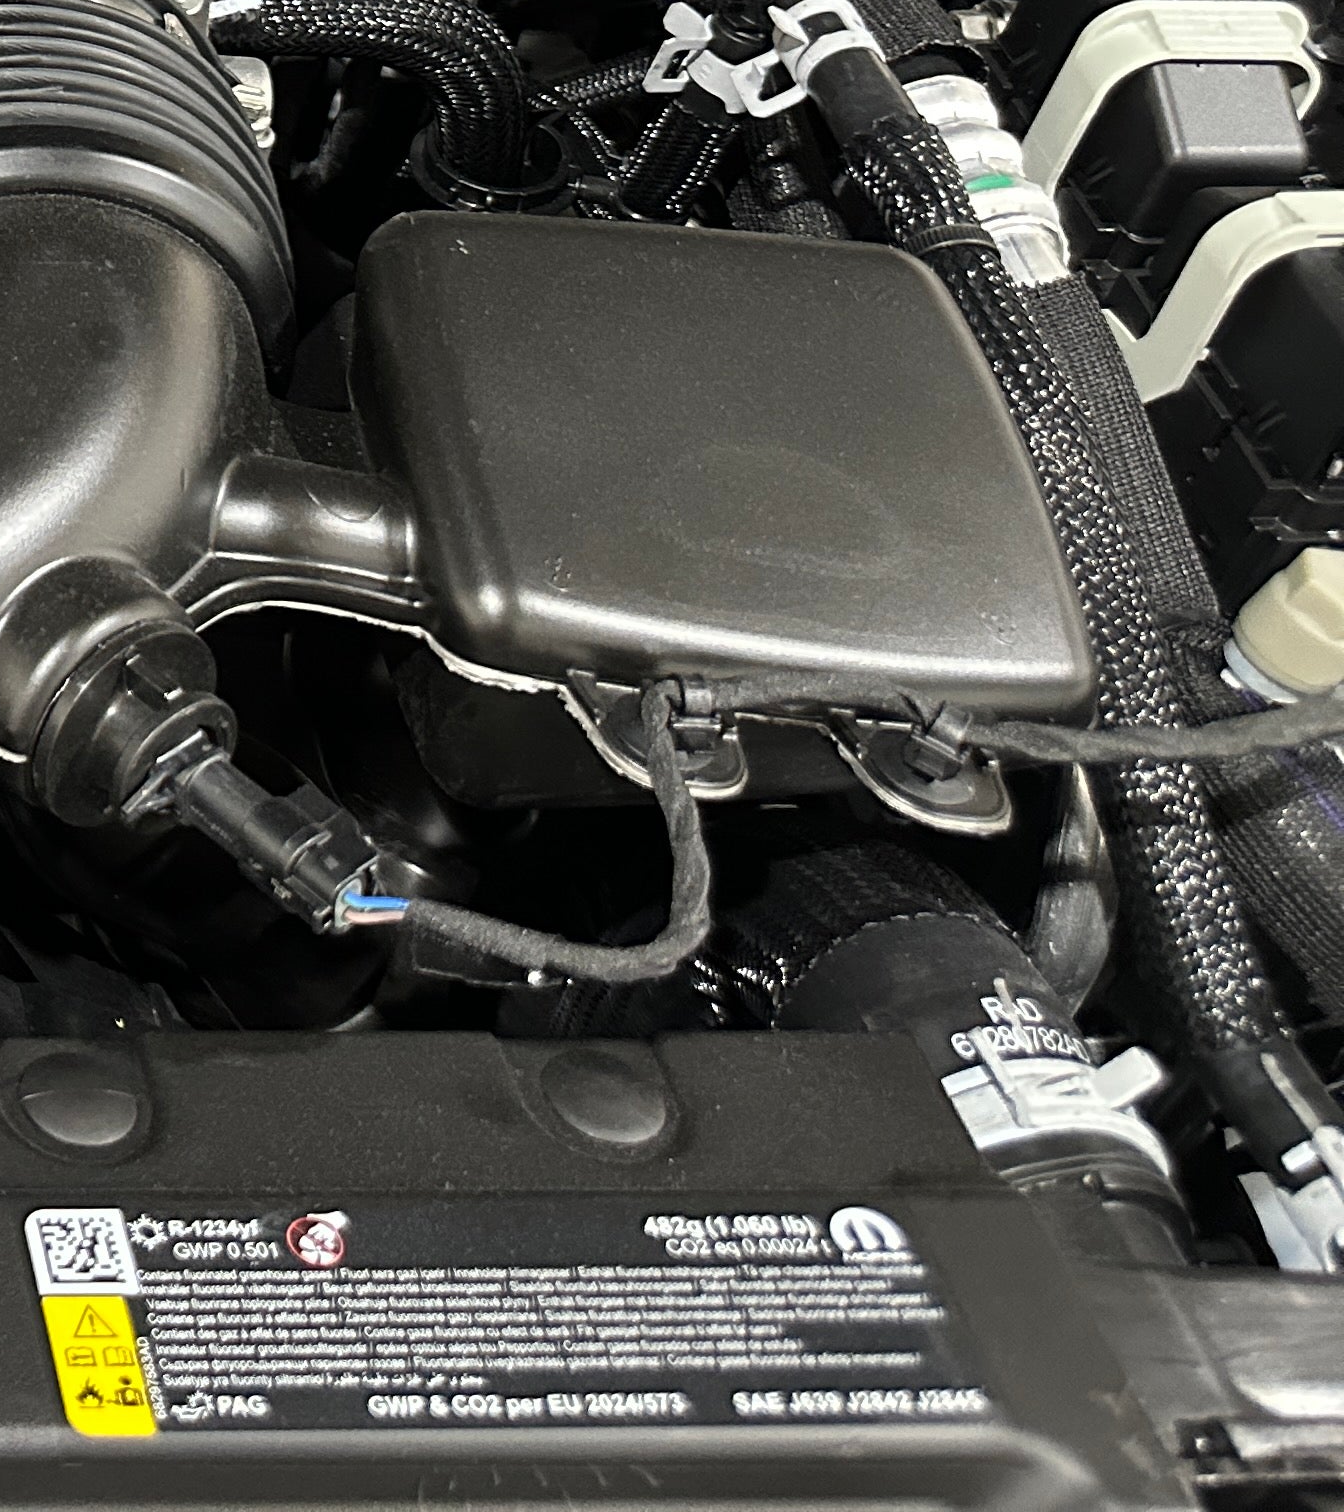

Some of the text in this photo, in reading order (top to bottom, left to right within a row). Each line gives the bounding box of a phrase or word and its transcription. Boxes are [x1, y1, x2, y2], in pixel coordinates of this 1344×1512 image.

[168, 1218, 262, 1240] R-1234yf
[173, 1241, 280, 1262] GWP 0.501
[665, 1238, 711, 1258] CO2
[714, 1241, 742, 1261] eq
[136, 1269, 182, 1281] Contains
[183, 1269, 237, 1281] fluorinated
[239, 1269, 299, 1283] greenhouse
[151, 1327, 197, 1339] Contient
[197, 1327, 217, 1339] des
[218, 1330, 238, 1342] gaz
[217, 1395, 267, 1419] PAG
[367, 1395, 426, 1417] GWP
[451, 1394, 504, 1417] CO2
[505, 1397, 543, 1420] per
[546, 1393, 582, 1416] EU
[732, 1391, 786, 1416] SAE
